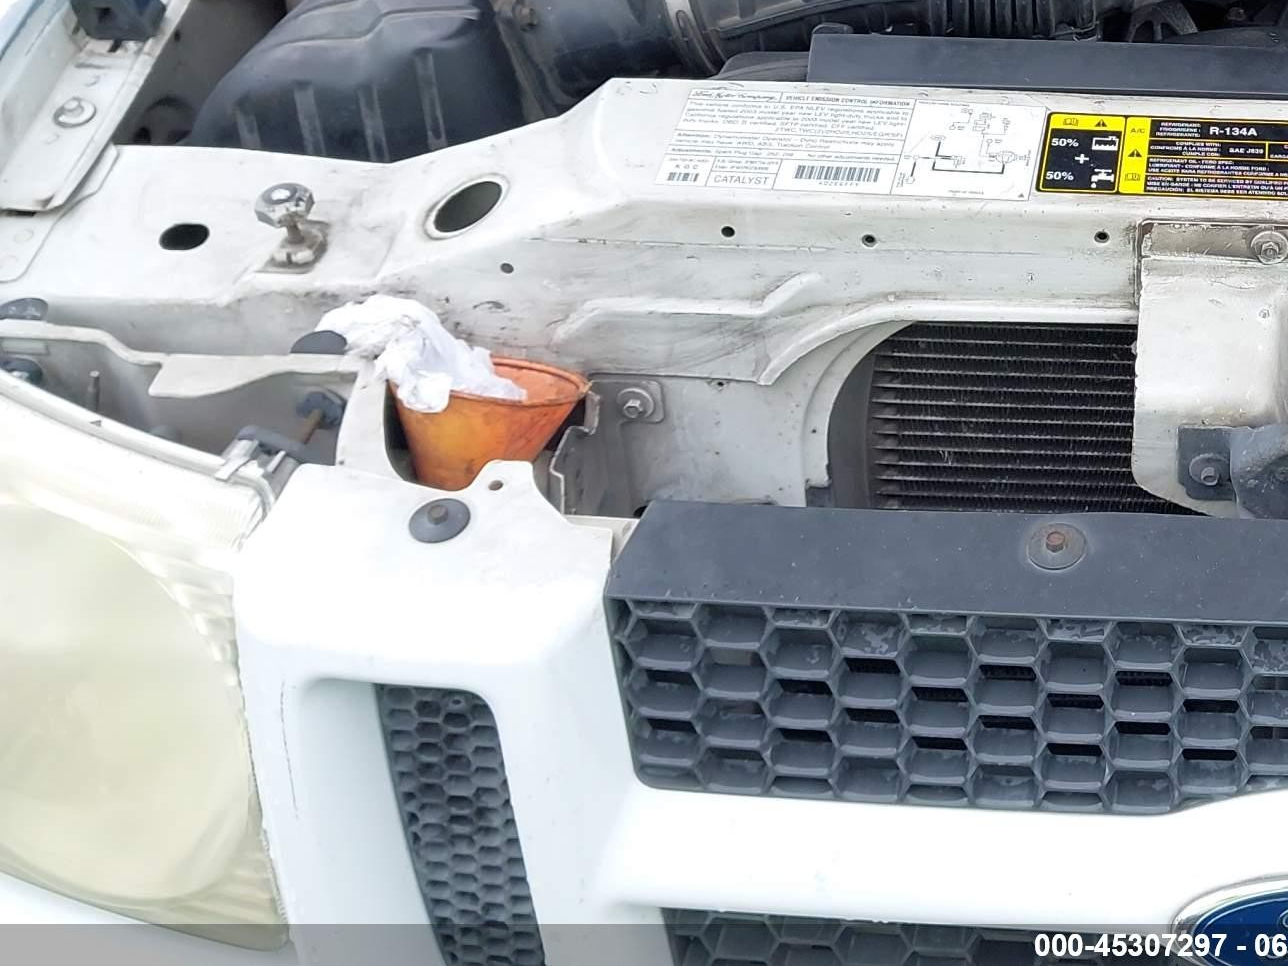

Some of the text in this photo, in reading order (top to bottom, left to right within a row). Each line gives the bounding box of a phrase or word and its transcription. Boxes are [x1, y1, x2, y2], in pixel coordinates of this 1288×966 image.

[1129, 127, 1146, 135] A/C
[1209, 126, 1259, 137] R-134A
[1051, 137, 1080, 148] 50%
[713, 174, 770, 185] CATALYST
[1045, 170, 1075, 181] 50%
